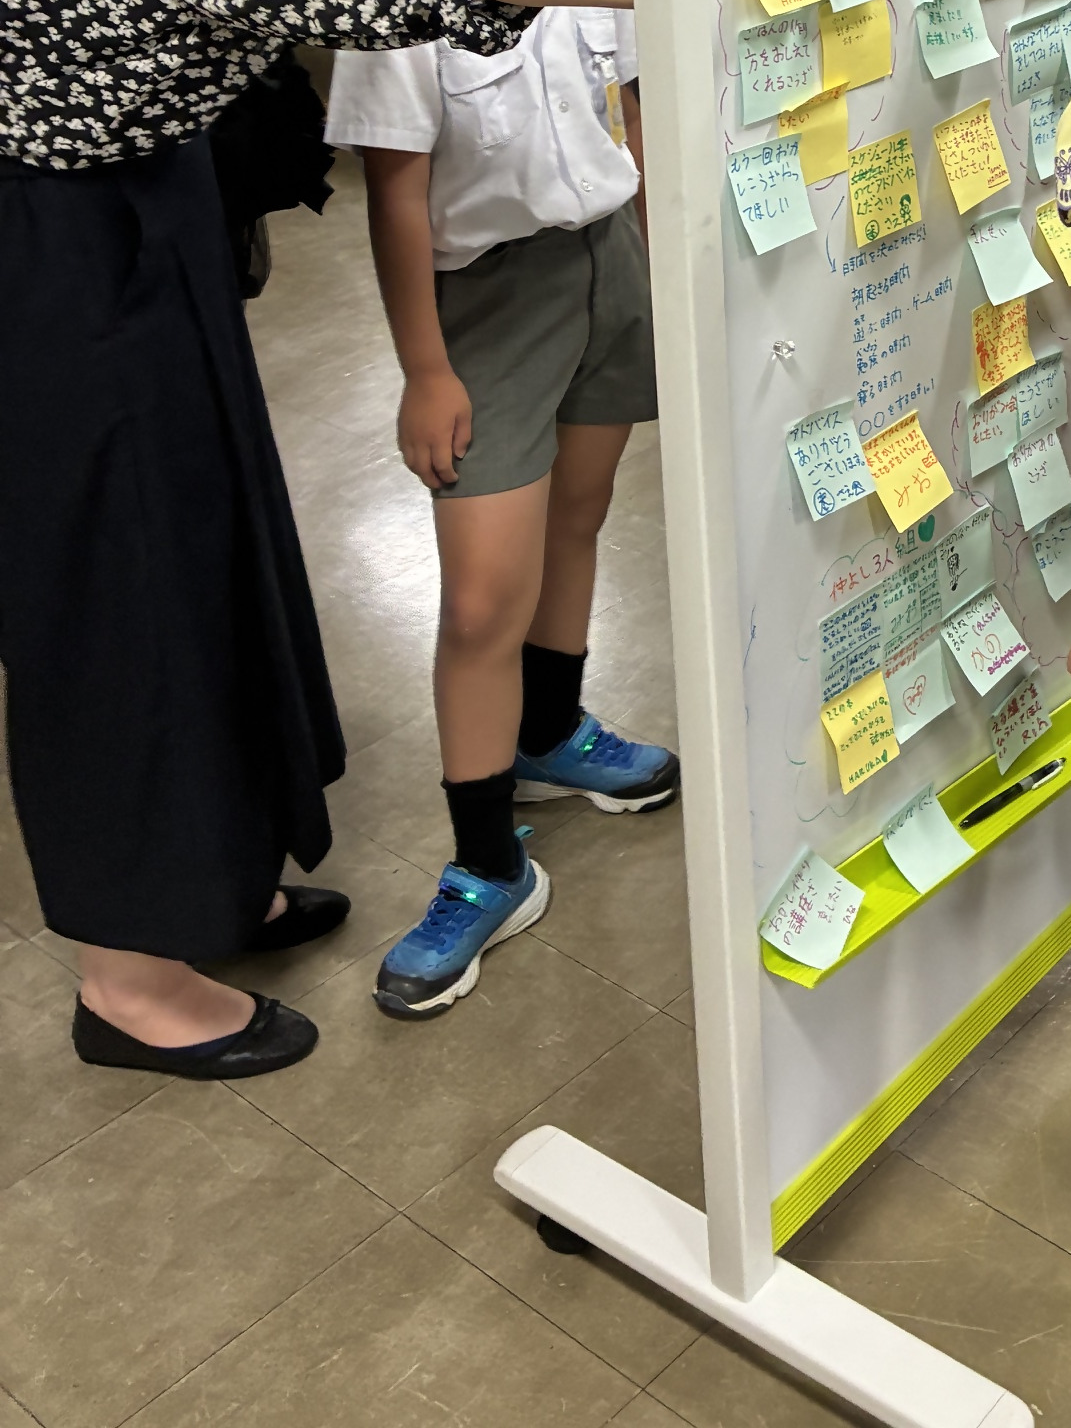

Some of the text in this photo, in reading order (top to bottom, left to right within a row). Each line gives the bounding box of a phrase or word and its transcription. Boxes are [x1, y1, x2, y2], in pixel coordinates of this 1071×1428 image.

[744, 42, 811, 74] 方をおしえて
[752, 66, 814, 93] くれるこうざ
[742, 196, 791, 223] てほしい
[851, 262, 911, 311] 朝起きる時間
[1021, 397, 1061, 427] ほしい
[794, 432, 851, 468] ありがとう
[807, 452, 866, 486] ございます。
